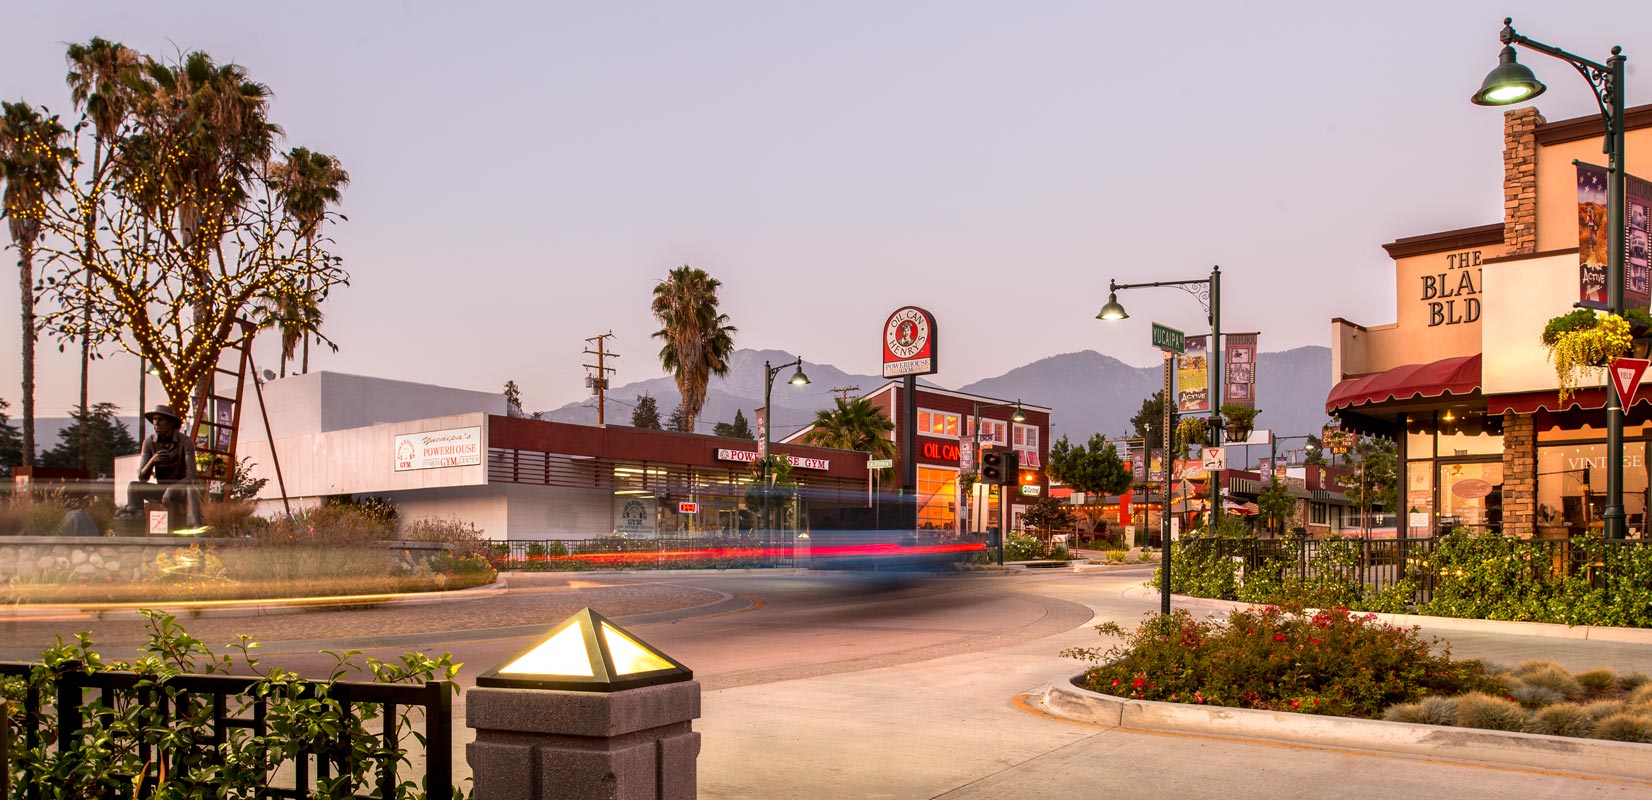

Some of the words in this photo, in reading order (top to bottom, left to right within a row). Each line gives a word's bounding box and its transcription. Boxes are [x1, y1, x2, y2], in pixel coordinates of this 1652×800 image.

[1447, 250, 1482, 270] THE
[890, 313, 905, 329] OIL
[906, 310, 925, 326] CAN
[1152, 327, 1180, 350] YUCAIPA
[889, 336, 926, 357] HENRY'S
[885, 359, 930, 371] POWERHOUSE
[1620, 372, 1632, 380] YIELD
[422, 432, 472, 446] Yucaipa's
[423, 443, 477, 457] POWERHOUSE
[924, 442, 941, 459] OIL
[399, 461, 412, 469] GYM
[440, 456, 457, 467] GYM
[804, 458, 826, 469] GYM
[1568, 455, 1643, 470] VINTGE
